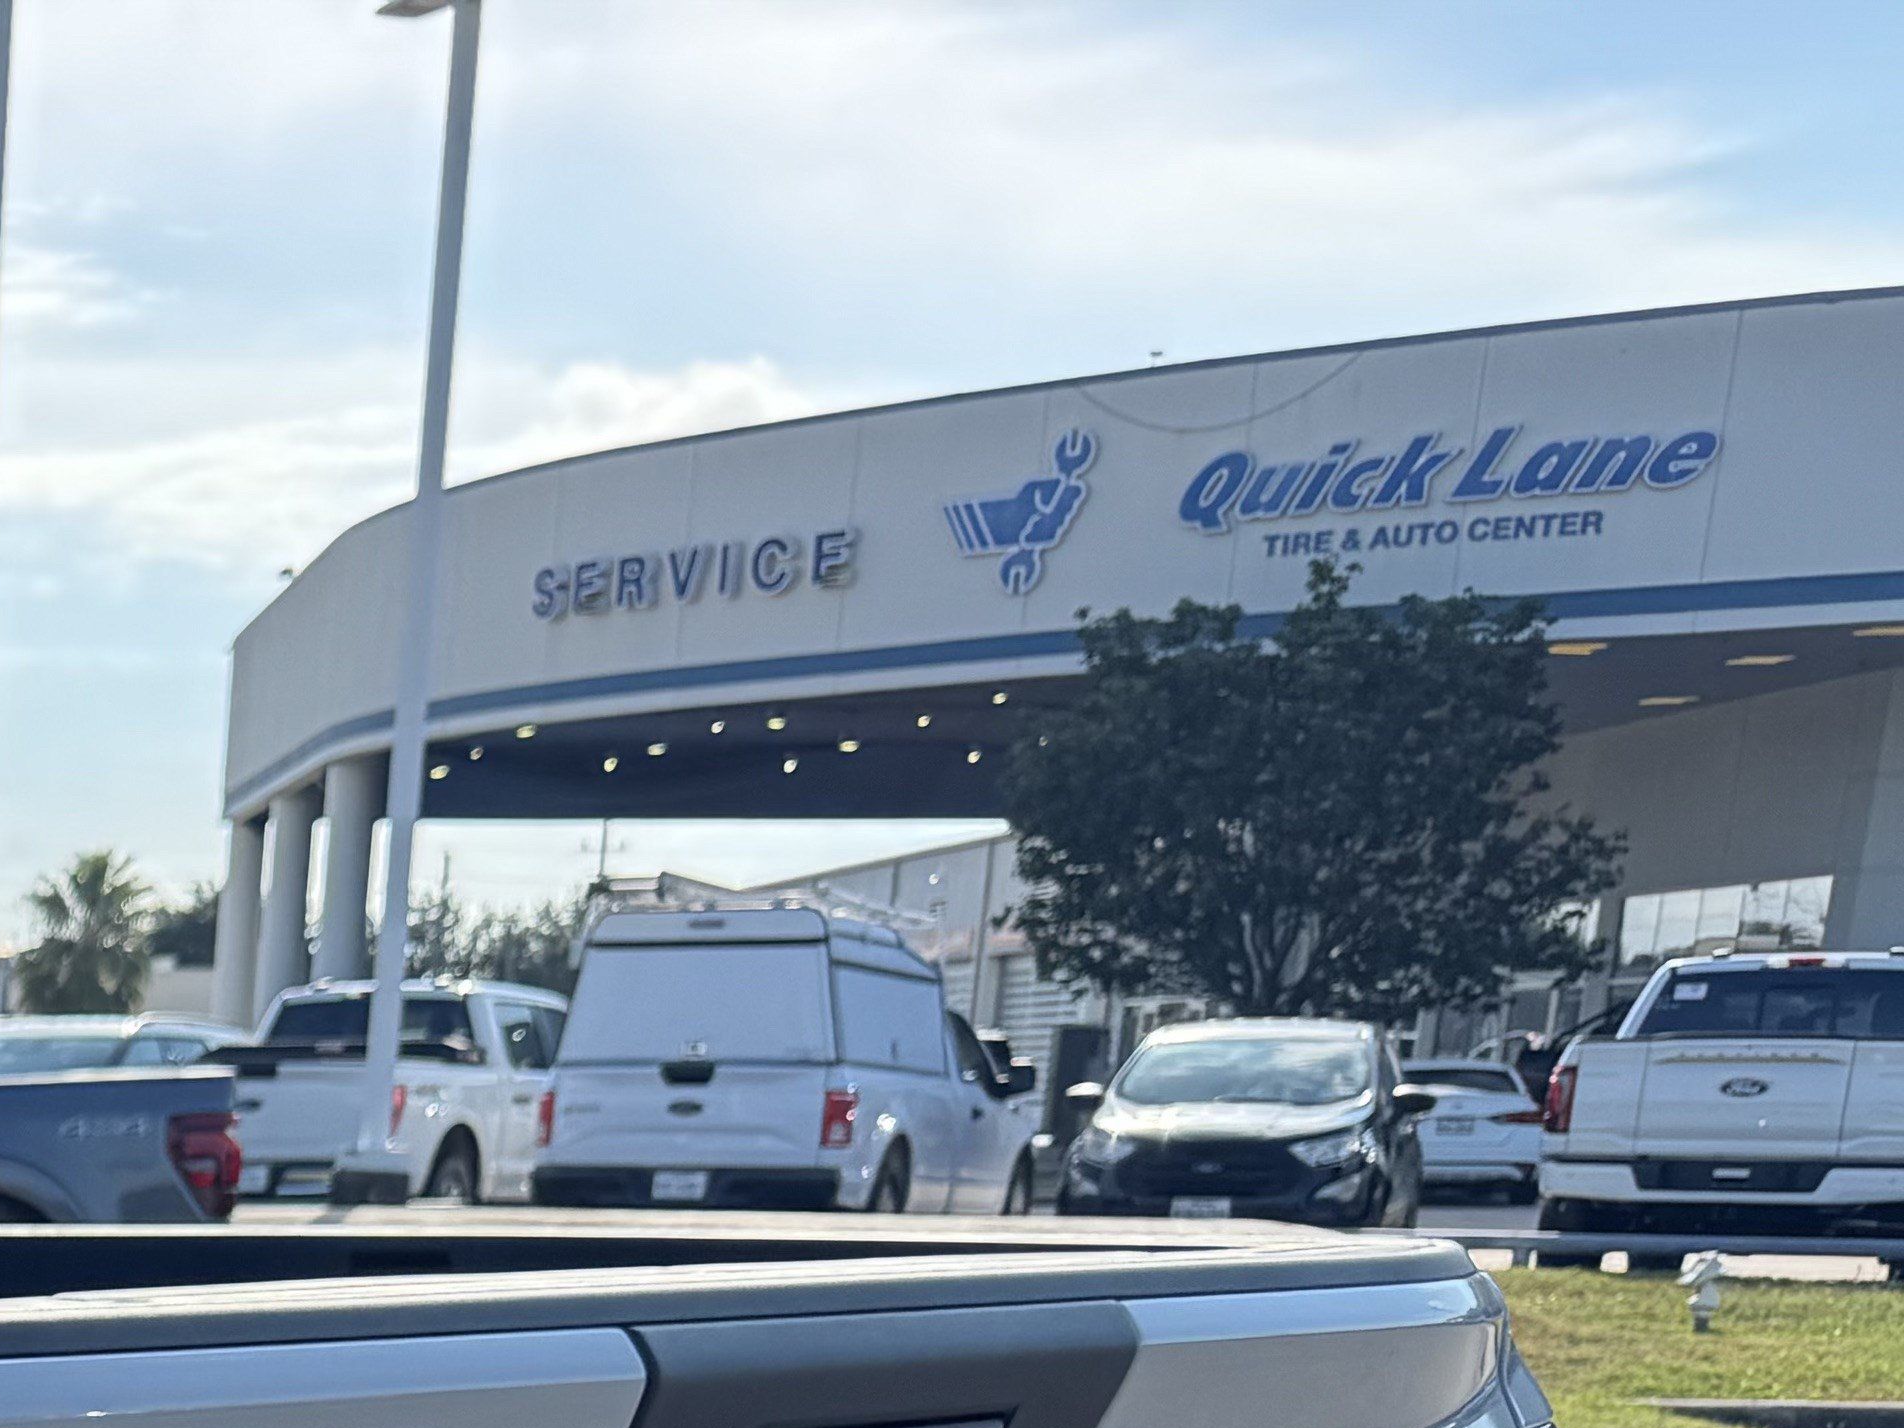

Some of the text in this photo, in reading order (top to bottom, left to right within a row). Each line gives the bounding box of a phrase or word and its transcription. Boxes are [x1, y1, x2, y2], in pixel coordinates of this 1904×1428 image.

[1178, 425, 1719, 534] Quick Lane
[531, 530, 860, 620] SERVICE
[1262, 510, 1605, 558] TIRE & AUTO CENTER
